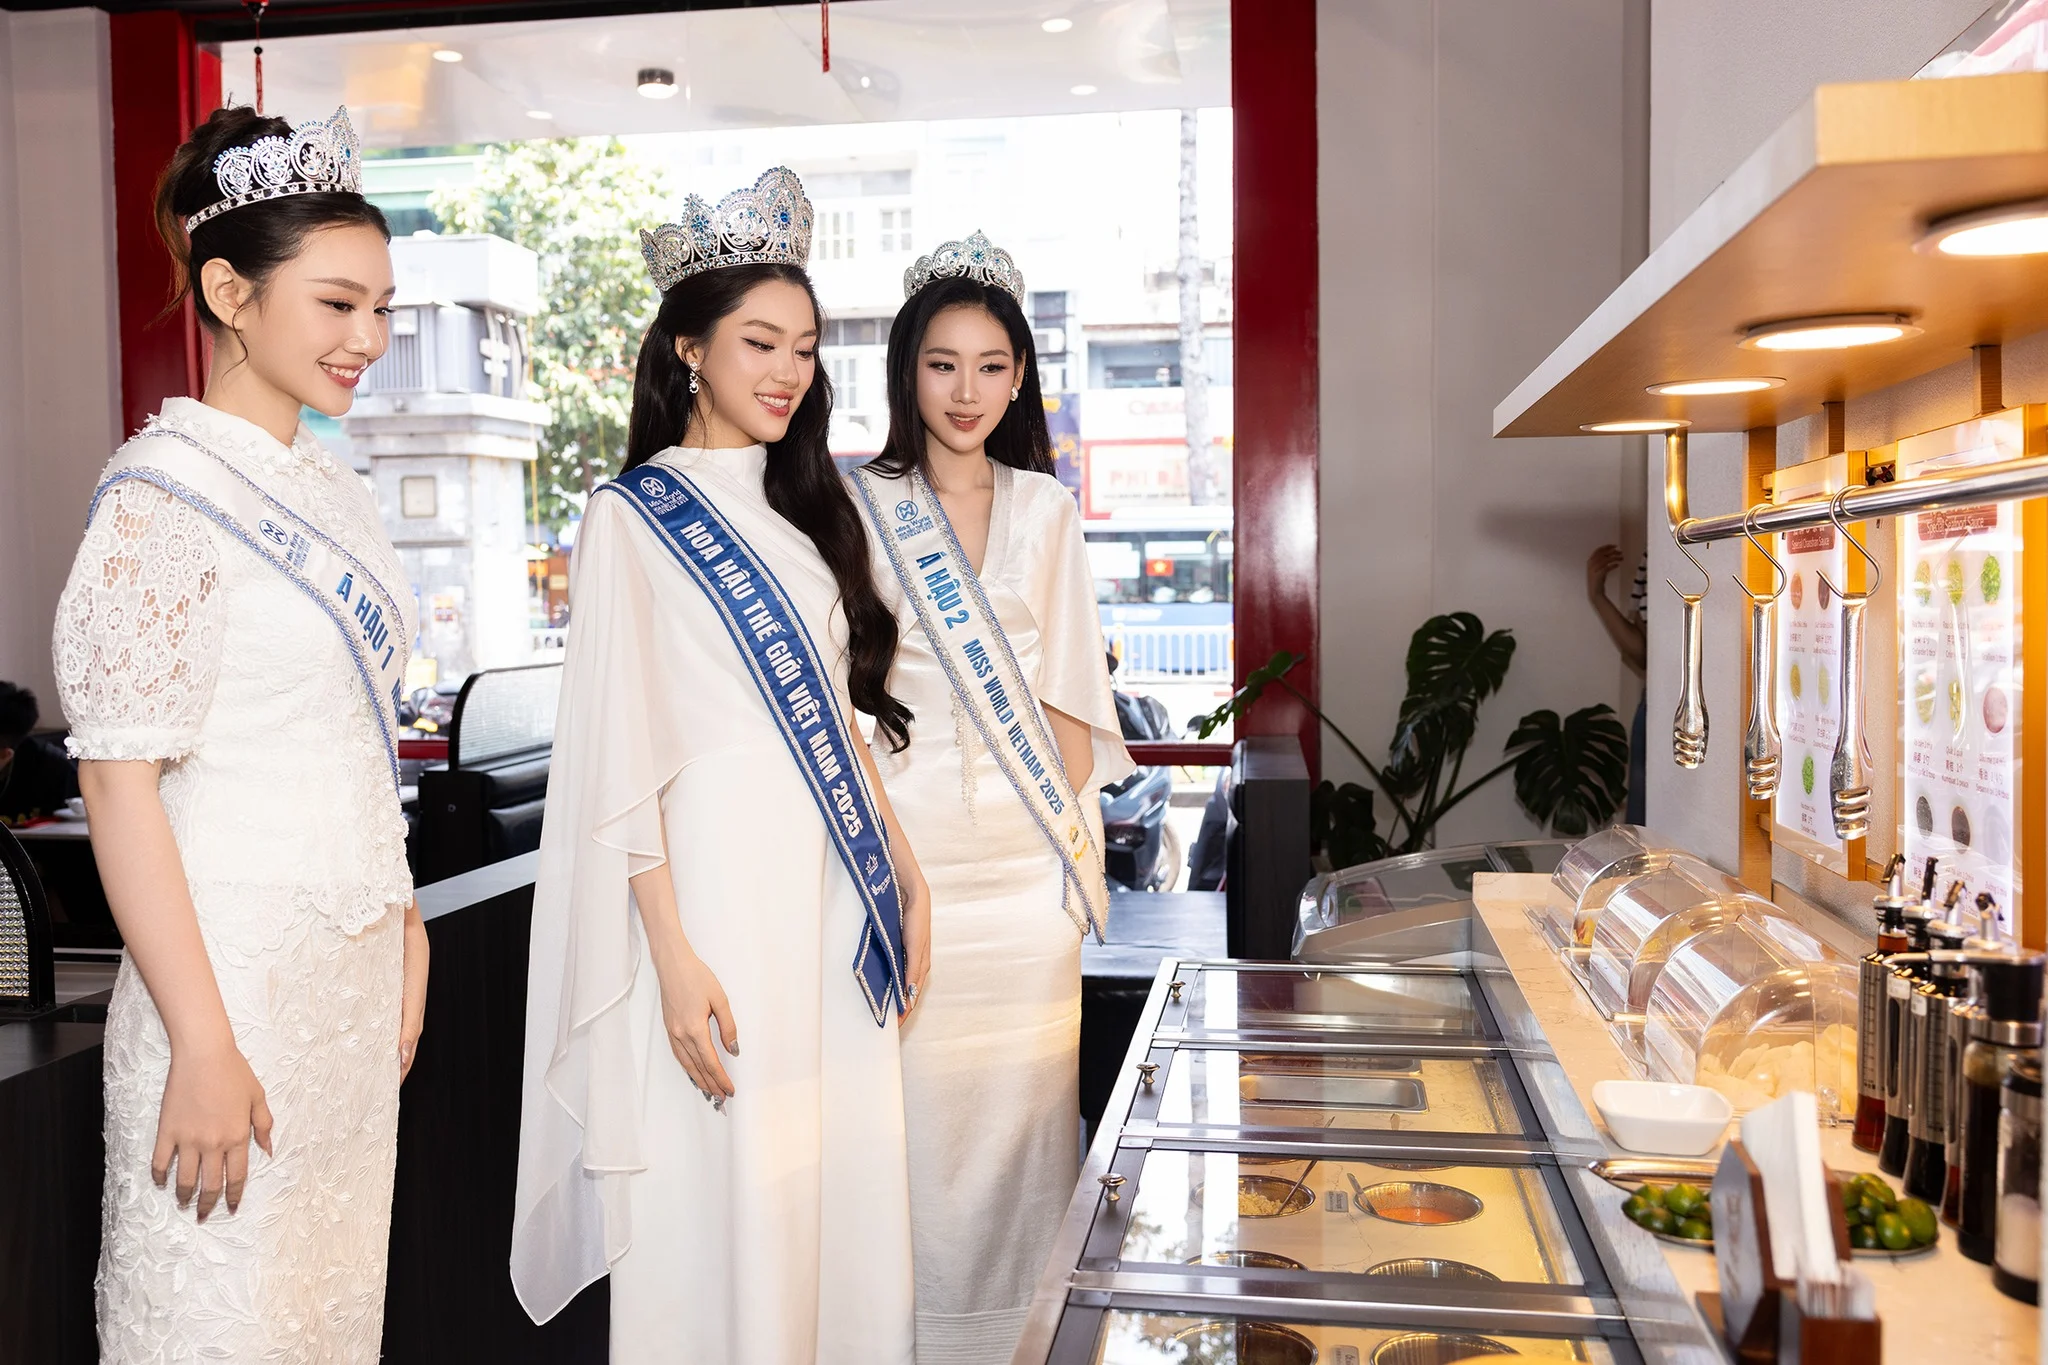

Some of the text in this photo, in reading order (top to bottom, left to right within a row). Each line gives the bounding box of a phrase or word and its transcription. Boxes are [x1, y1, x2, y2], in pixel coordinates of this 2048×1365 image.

[335, 571, 395, 671] Á HẬU 1
[680, 520, 864, 839] HOA HẬU THẾ GIỚI VIỆT NAM 2025
[916, 551, 1065, 816] Á HẬU 2 MISS WORLD VIETNAM 2025
